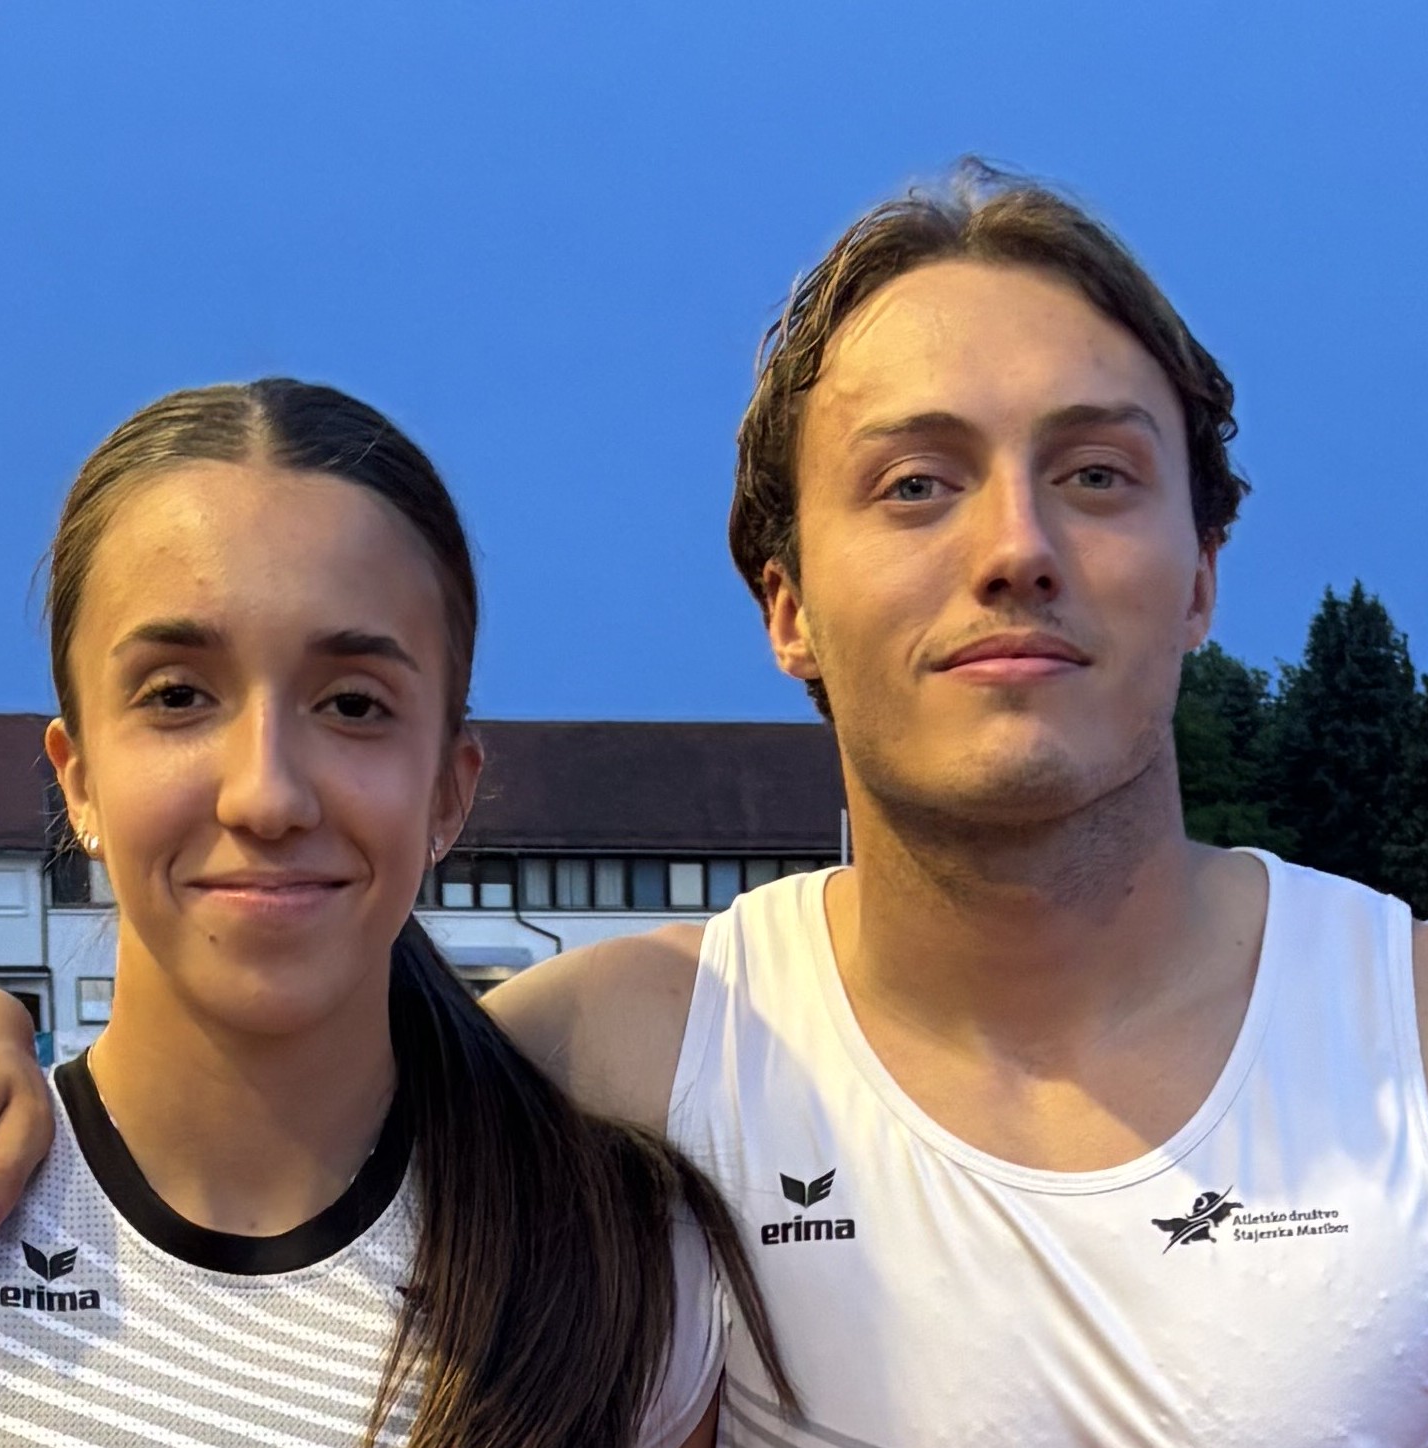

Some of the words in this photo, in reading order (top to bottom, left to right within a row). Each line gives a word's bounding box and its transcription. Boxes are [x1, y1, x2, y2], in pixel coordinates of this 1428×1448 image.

[760, 1215, 855, 1245] erima
[1232, 1211, 1286, 1226] Atletsko
[1233, 1226, 1294, 1243] Štajerska
[1296, 1222, 1349, 1236] Maribor
[0, 1285, 101, 1312] erima
